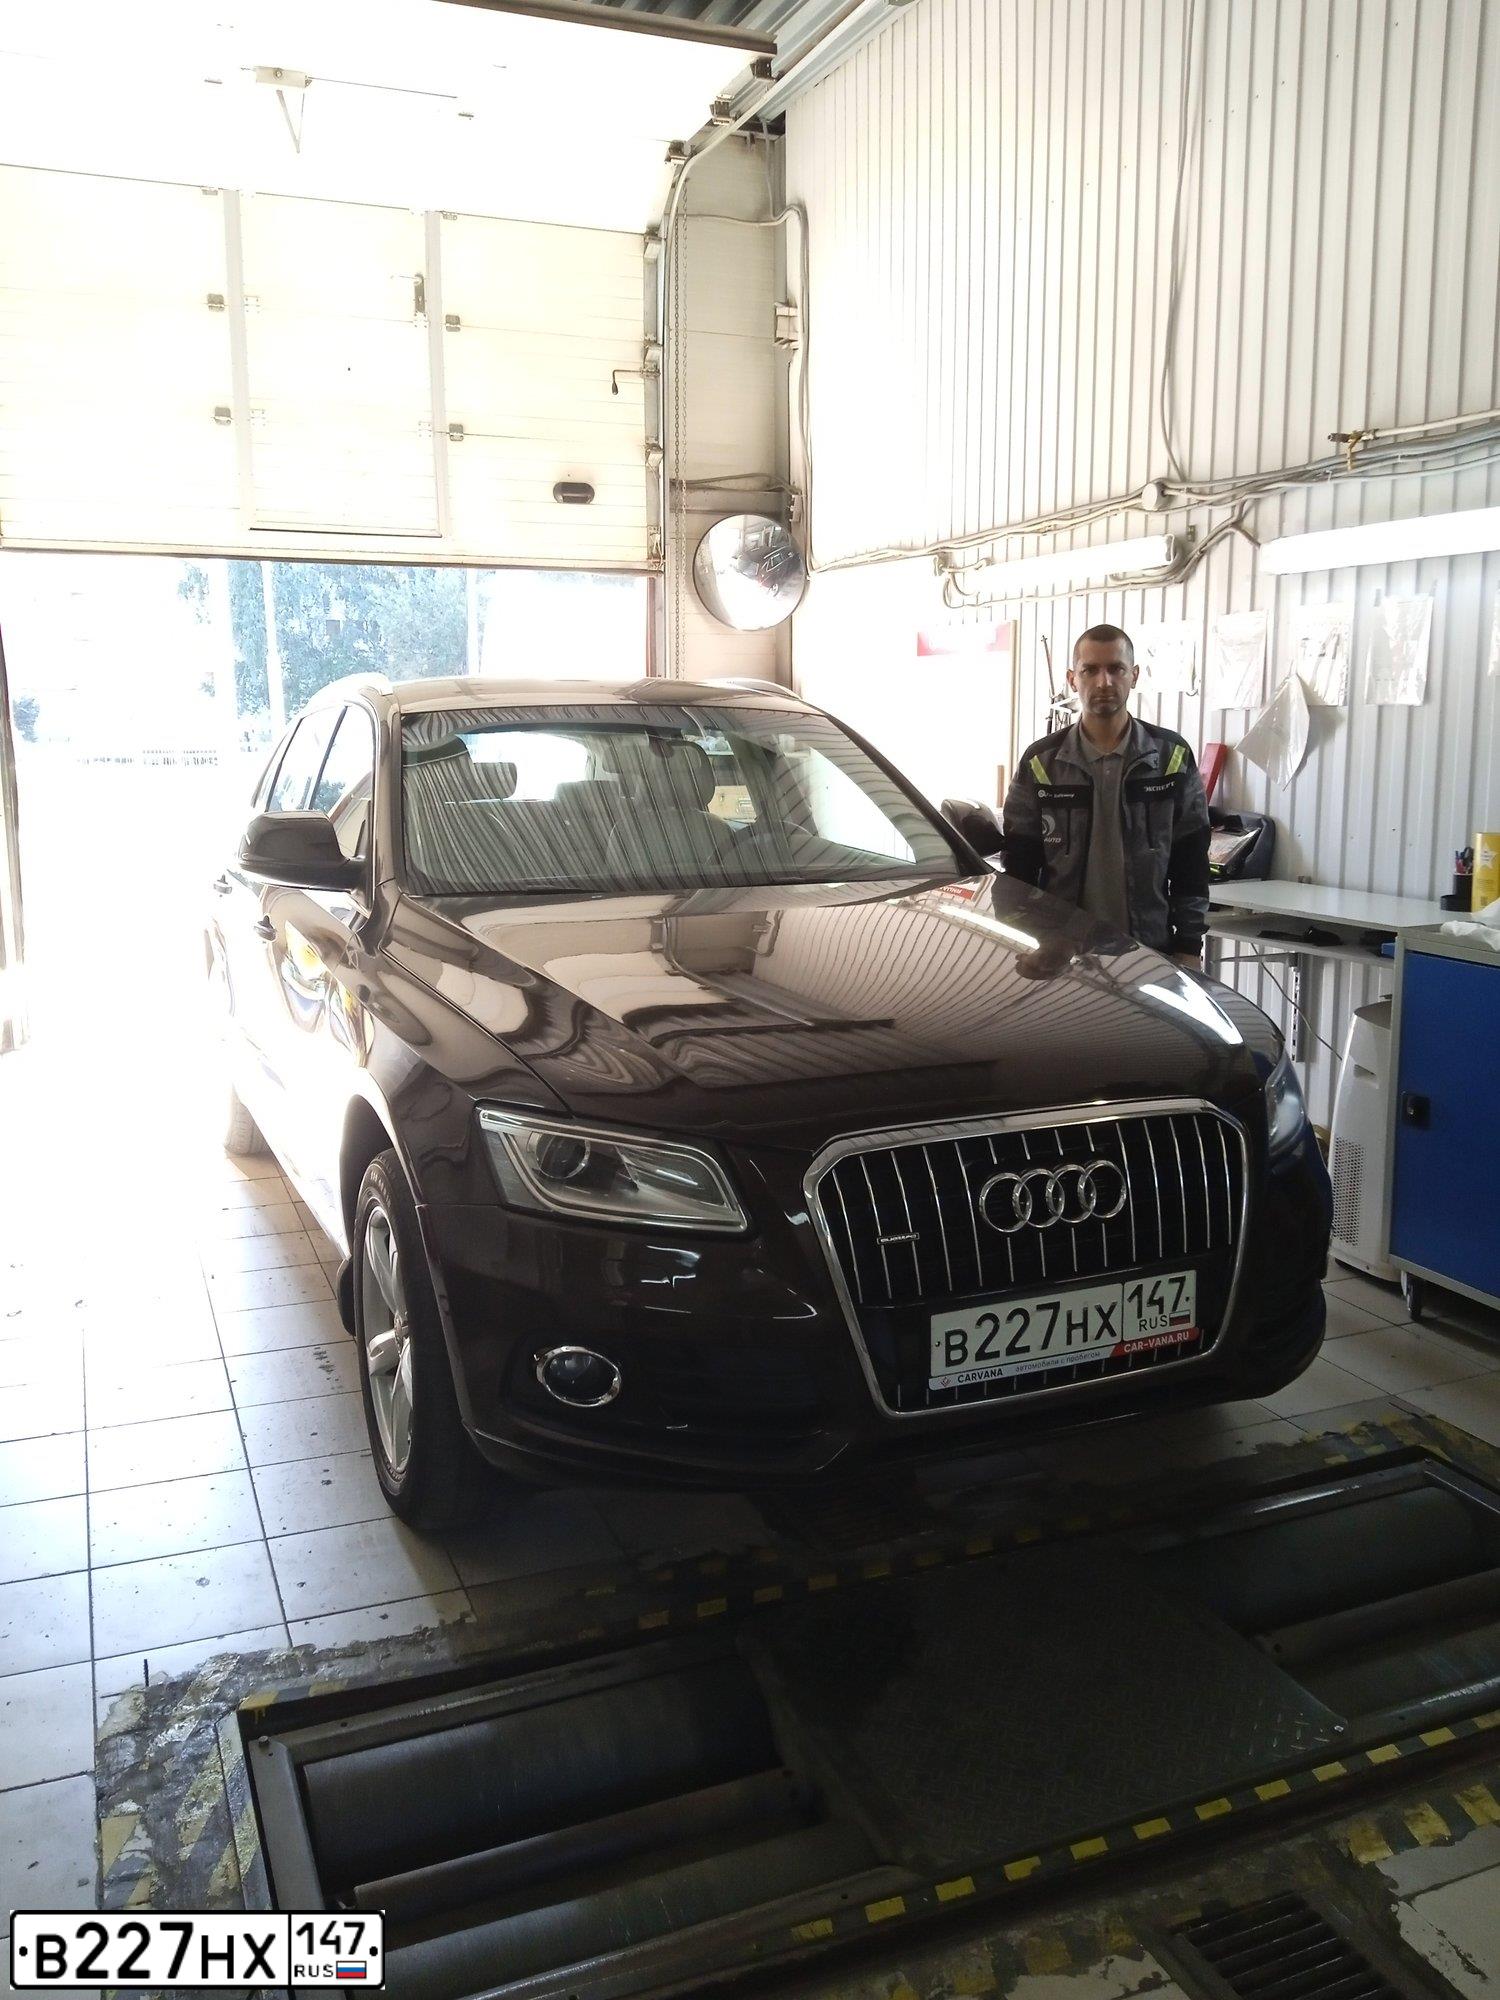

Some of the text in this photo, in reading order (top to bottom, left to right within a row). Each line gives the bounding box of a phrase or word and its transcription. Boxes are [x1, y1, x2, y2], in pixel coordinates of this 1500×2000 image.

[1127, 1275, 1187, 1320] 147
[944, 1301, 1118, 1368] В227НХ
[1138, 1314, 1168, 1333] RUS
[1123, 1330, 1190, 1353] CAR-VANA.RU
[1015, 1358, 1059, 1373] автомобили
[1066, 1350, 1101, 1364] пробегом
[957, 1367, 1004, 1384] CARVANA
